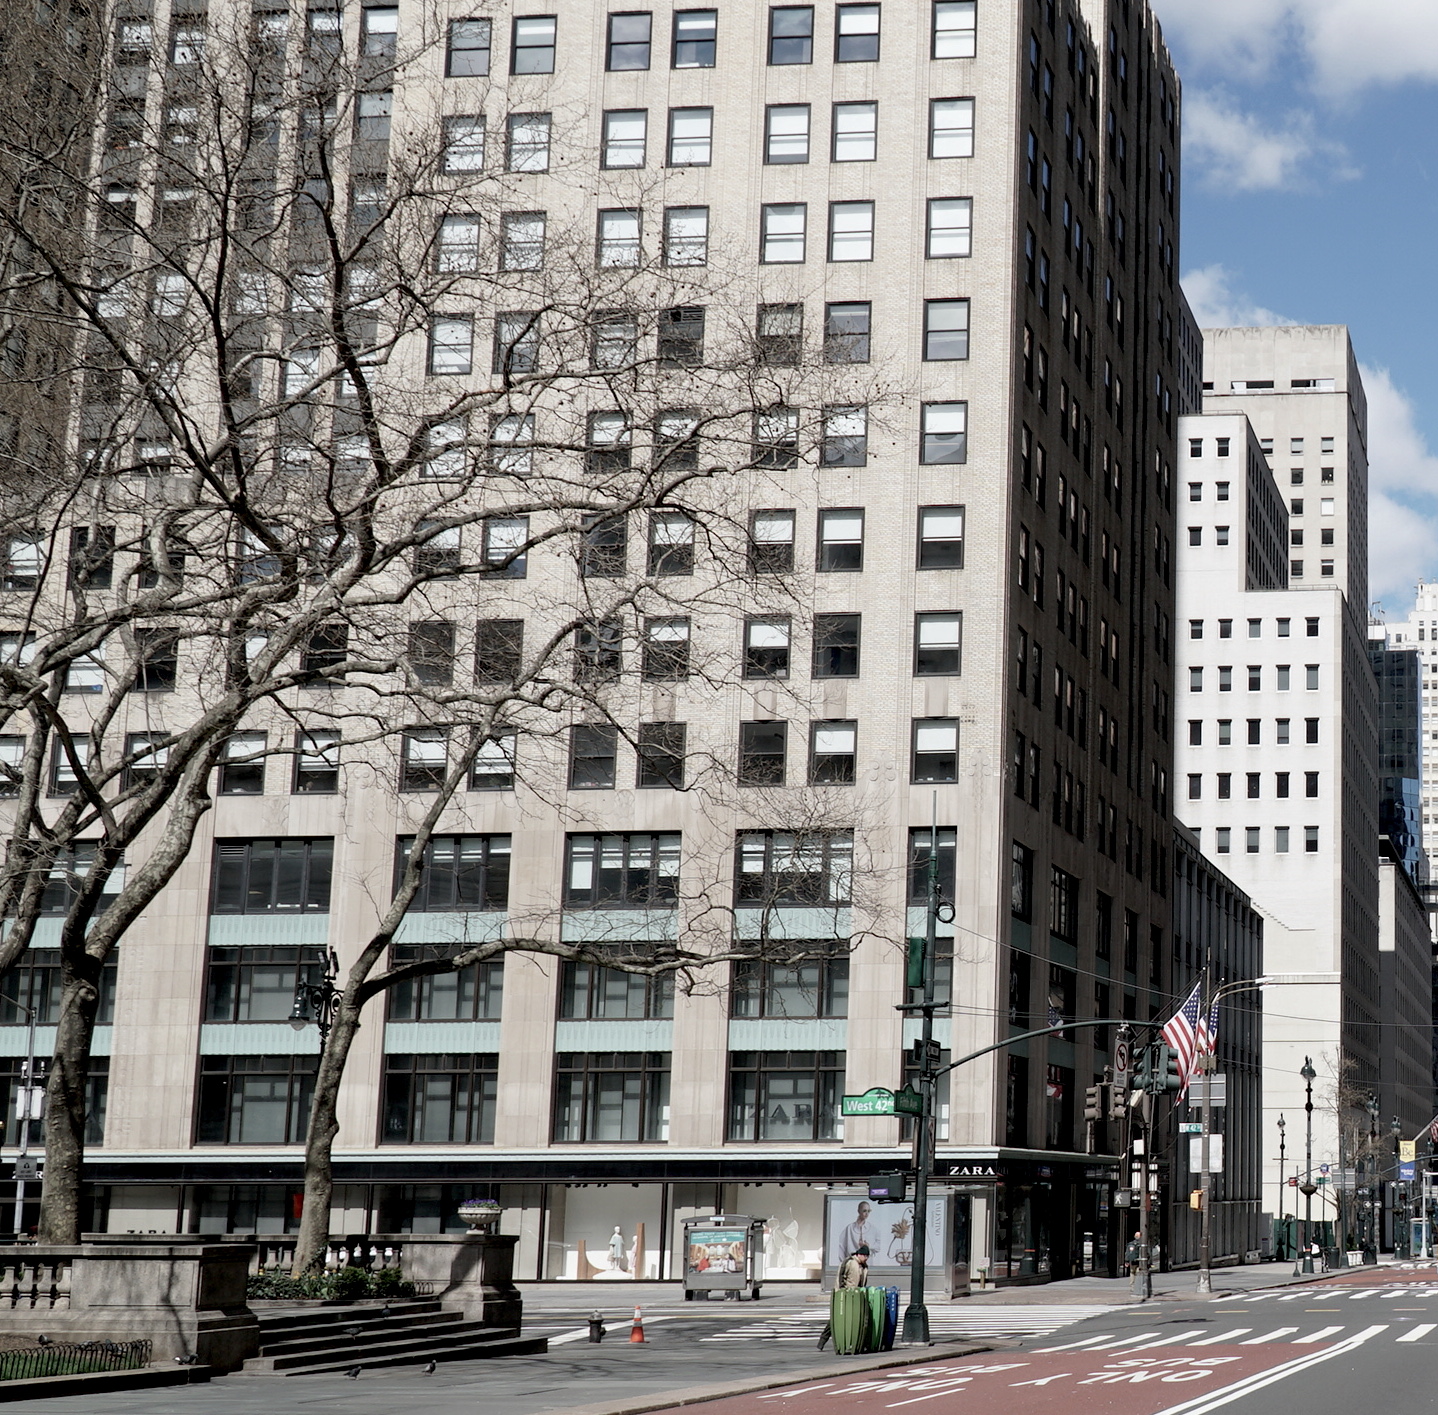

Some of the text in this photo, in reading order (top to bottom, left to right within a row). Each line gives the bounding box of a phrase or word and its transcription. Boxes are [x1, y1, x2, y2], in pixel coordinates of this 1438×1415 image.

[846, 1100, 873, 1111] West
[949, 1166, 995, 1176] ZARA
[1103, 1356, 1243, 1369] BUS
[886, 1362, 1031, 1378] BUS
[1008, 1369, 1214, 1387] ONLY
